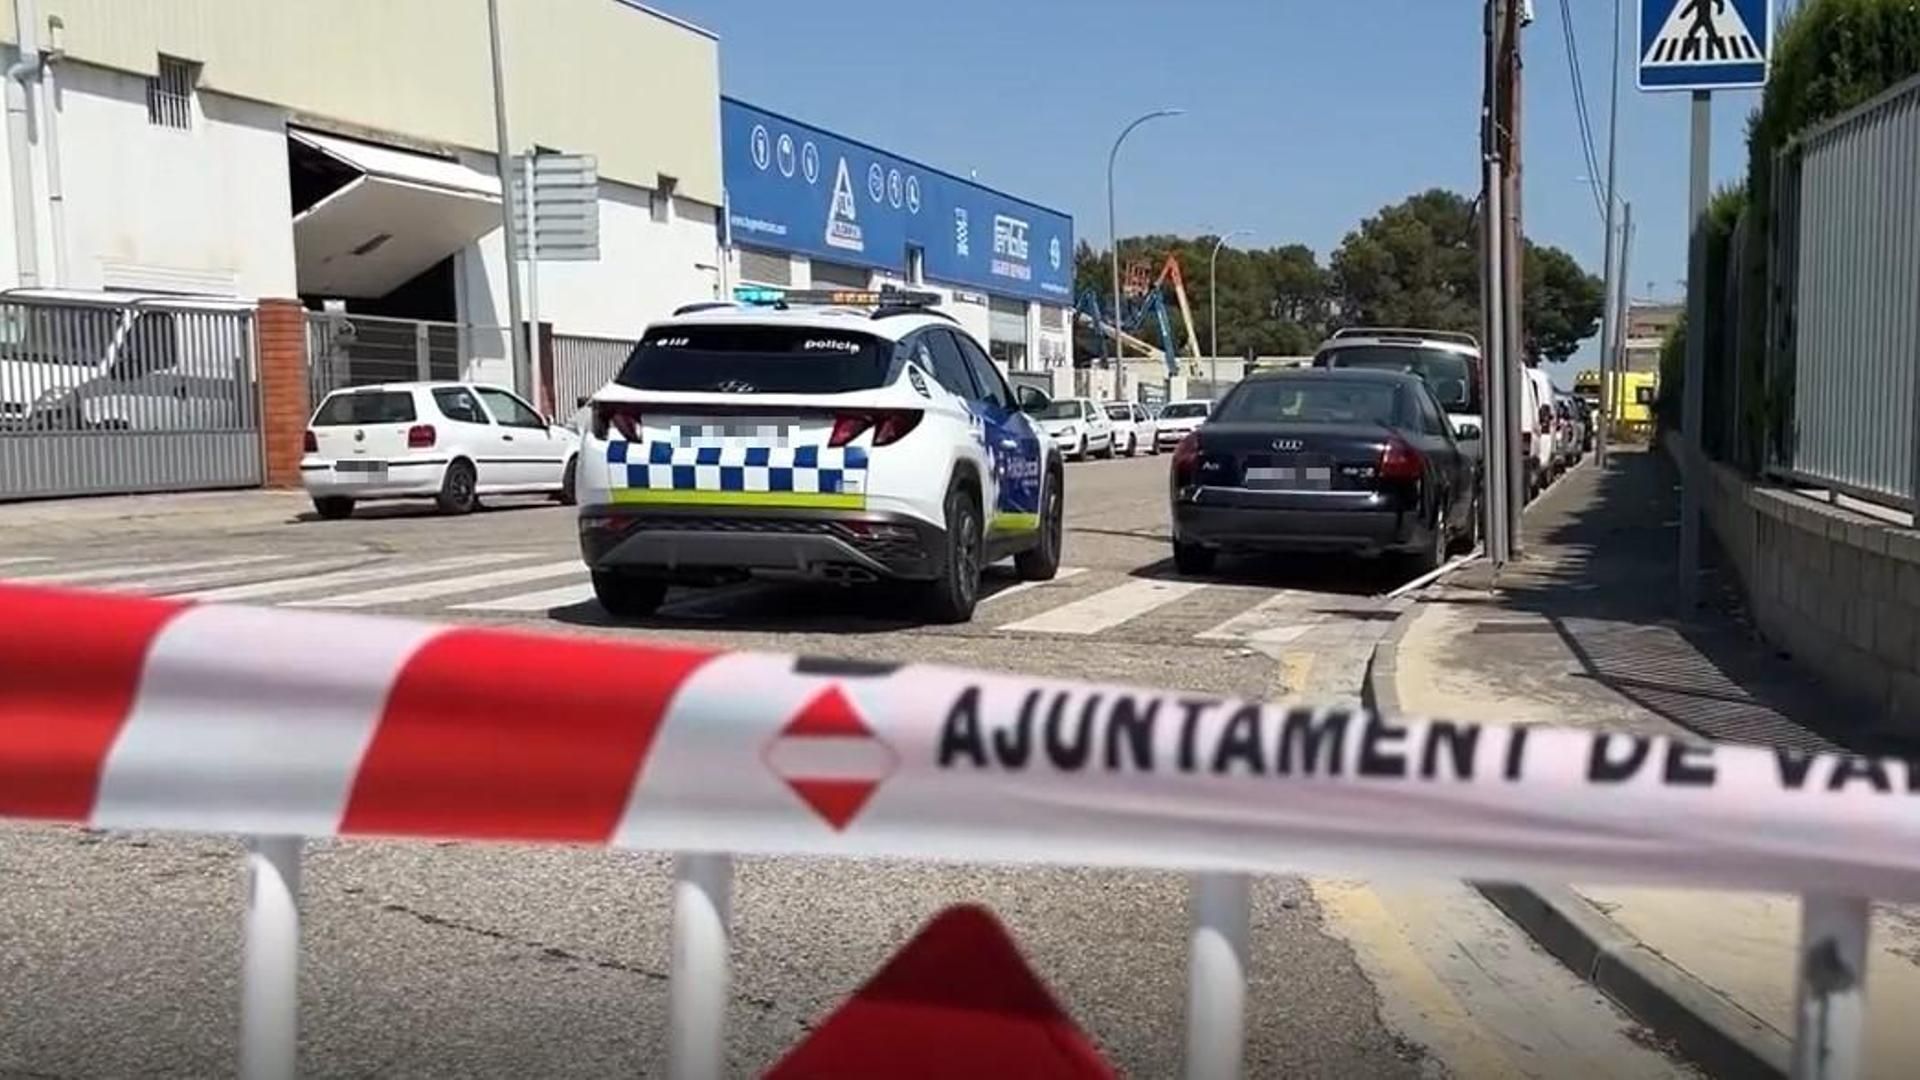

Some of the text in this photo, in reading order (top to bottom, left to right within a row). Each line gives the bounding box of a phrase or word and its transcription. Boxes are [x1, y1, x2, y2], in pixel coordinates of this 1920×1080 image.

[804, 339, 860, 353] policia
[936, 685, 1527, 777] AJUNTAMENT
[1584, 732, 1717, 786] DE
